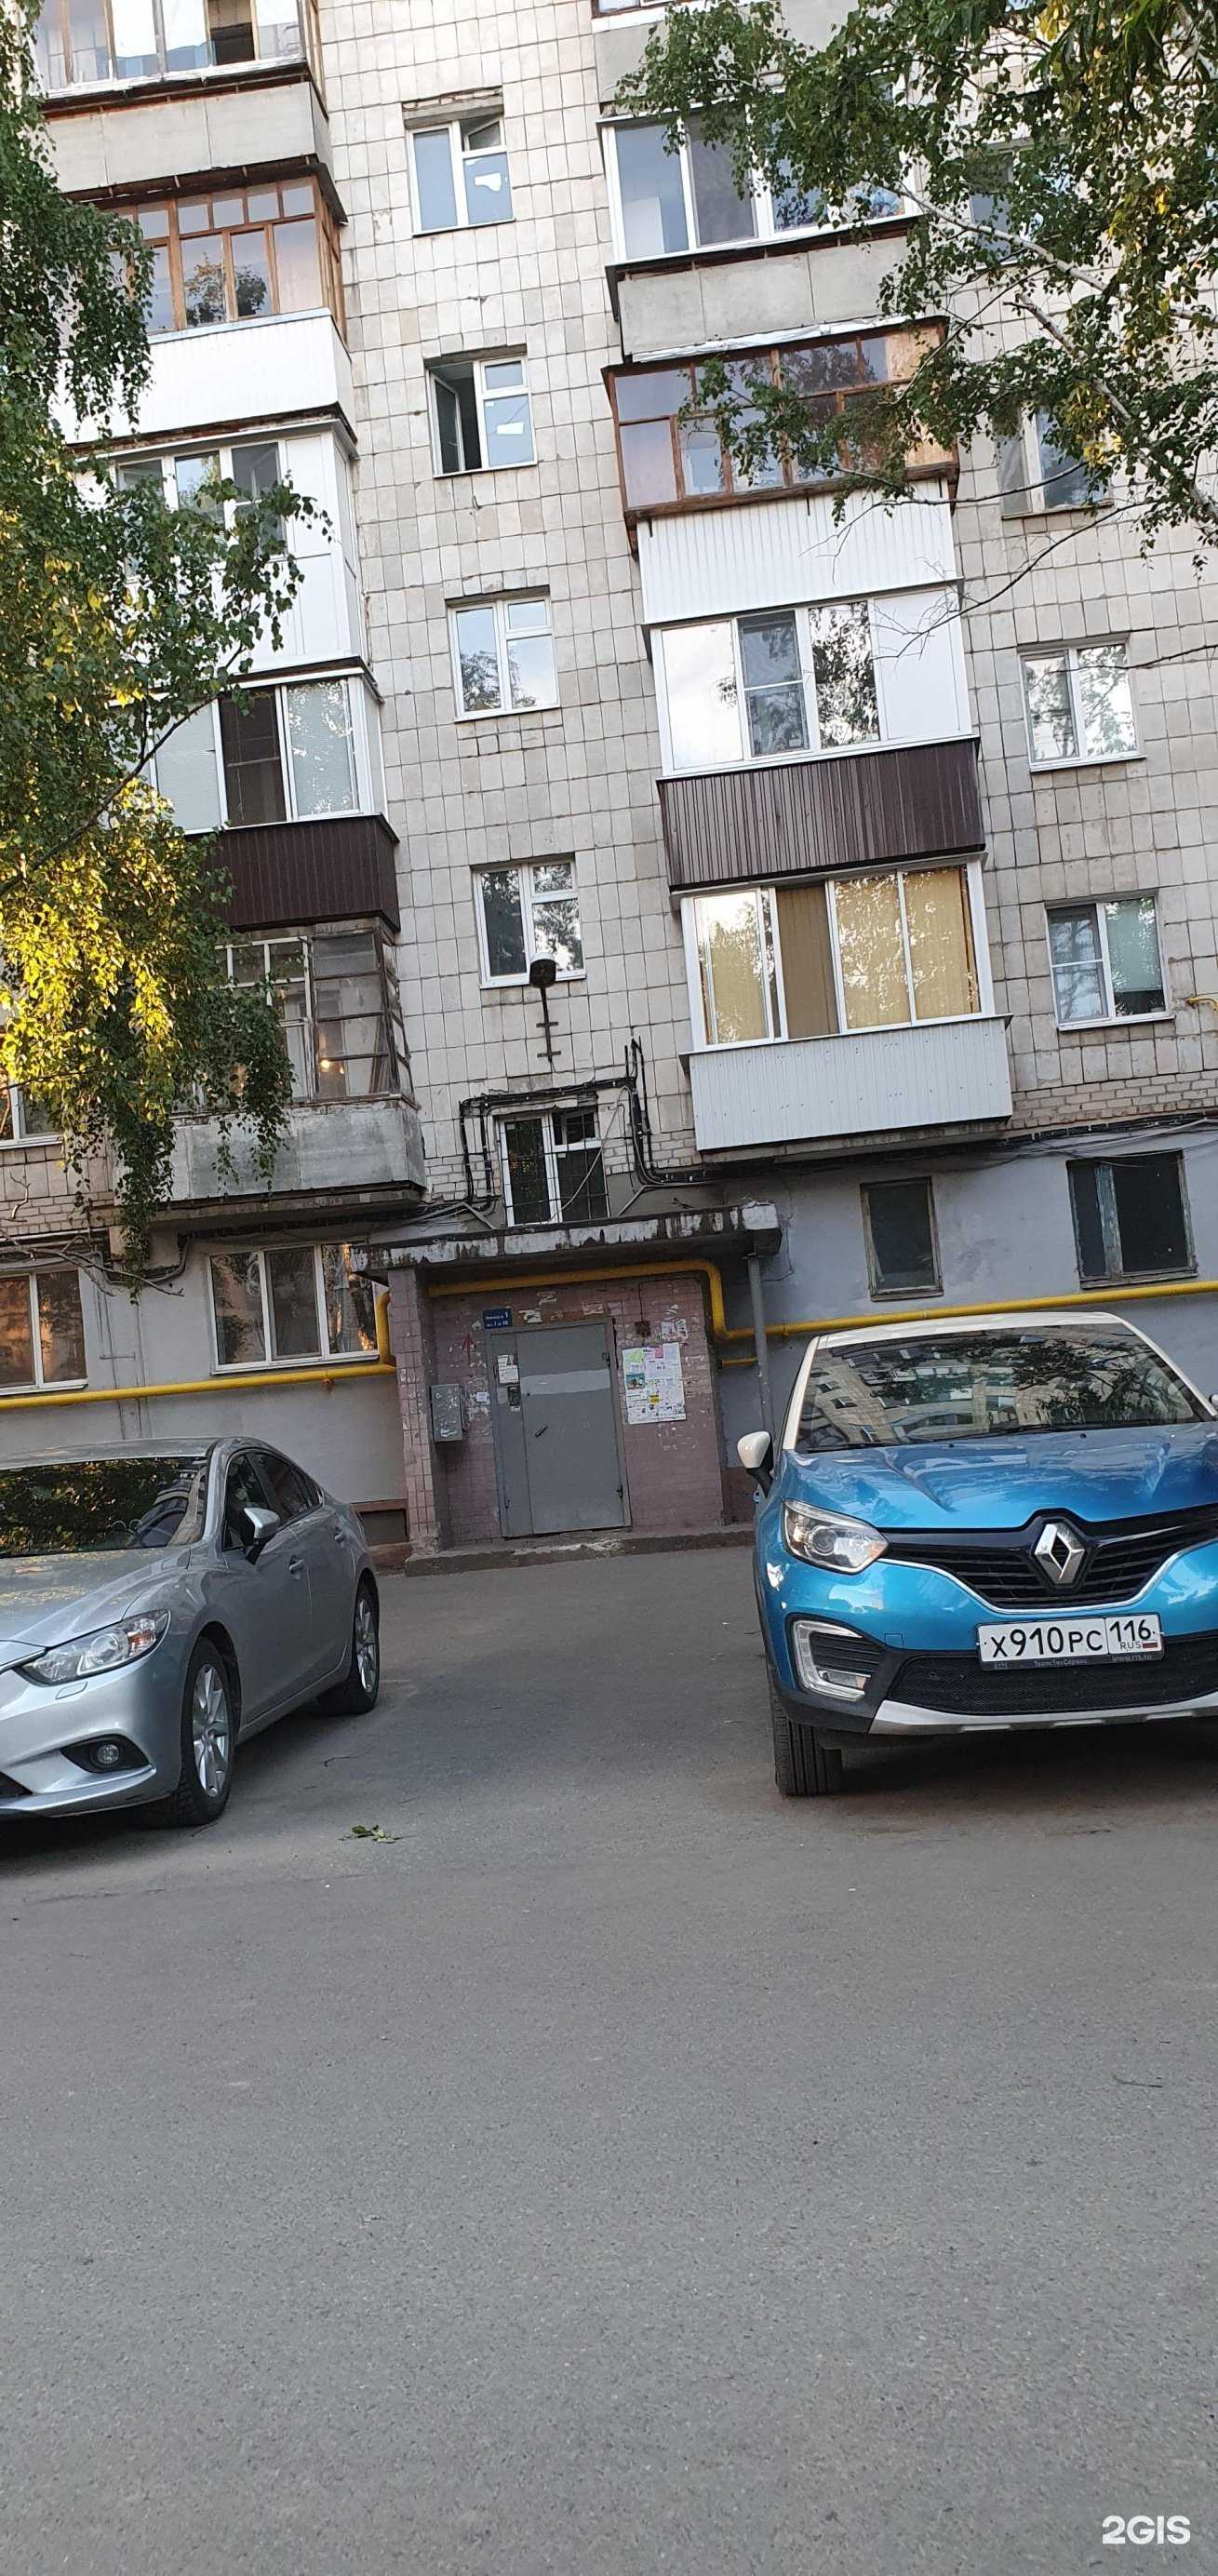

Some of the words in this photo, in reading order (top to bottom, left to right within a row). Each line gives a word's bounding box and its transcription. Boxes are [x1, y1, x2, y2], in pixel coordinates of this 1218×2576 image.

[991, 1627, 1103, 1658] Х910РС
[1109, 1619, 1152, 1643] 116
[1119, 1641, 1142, 1650] RUS
